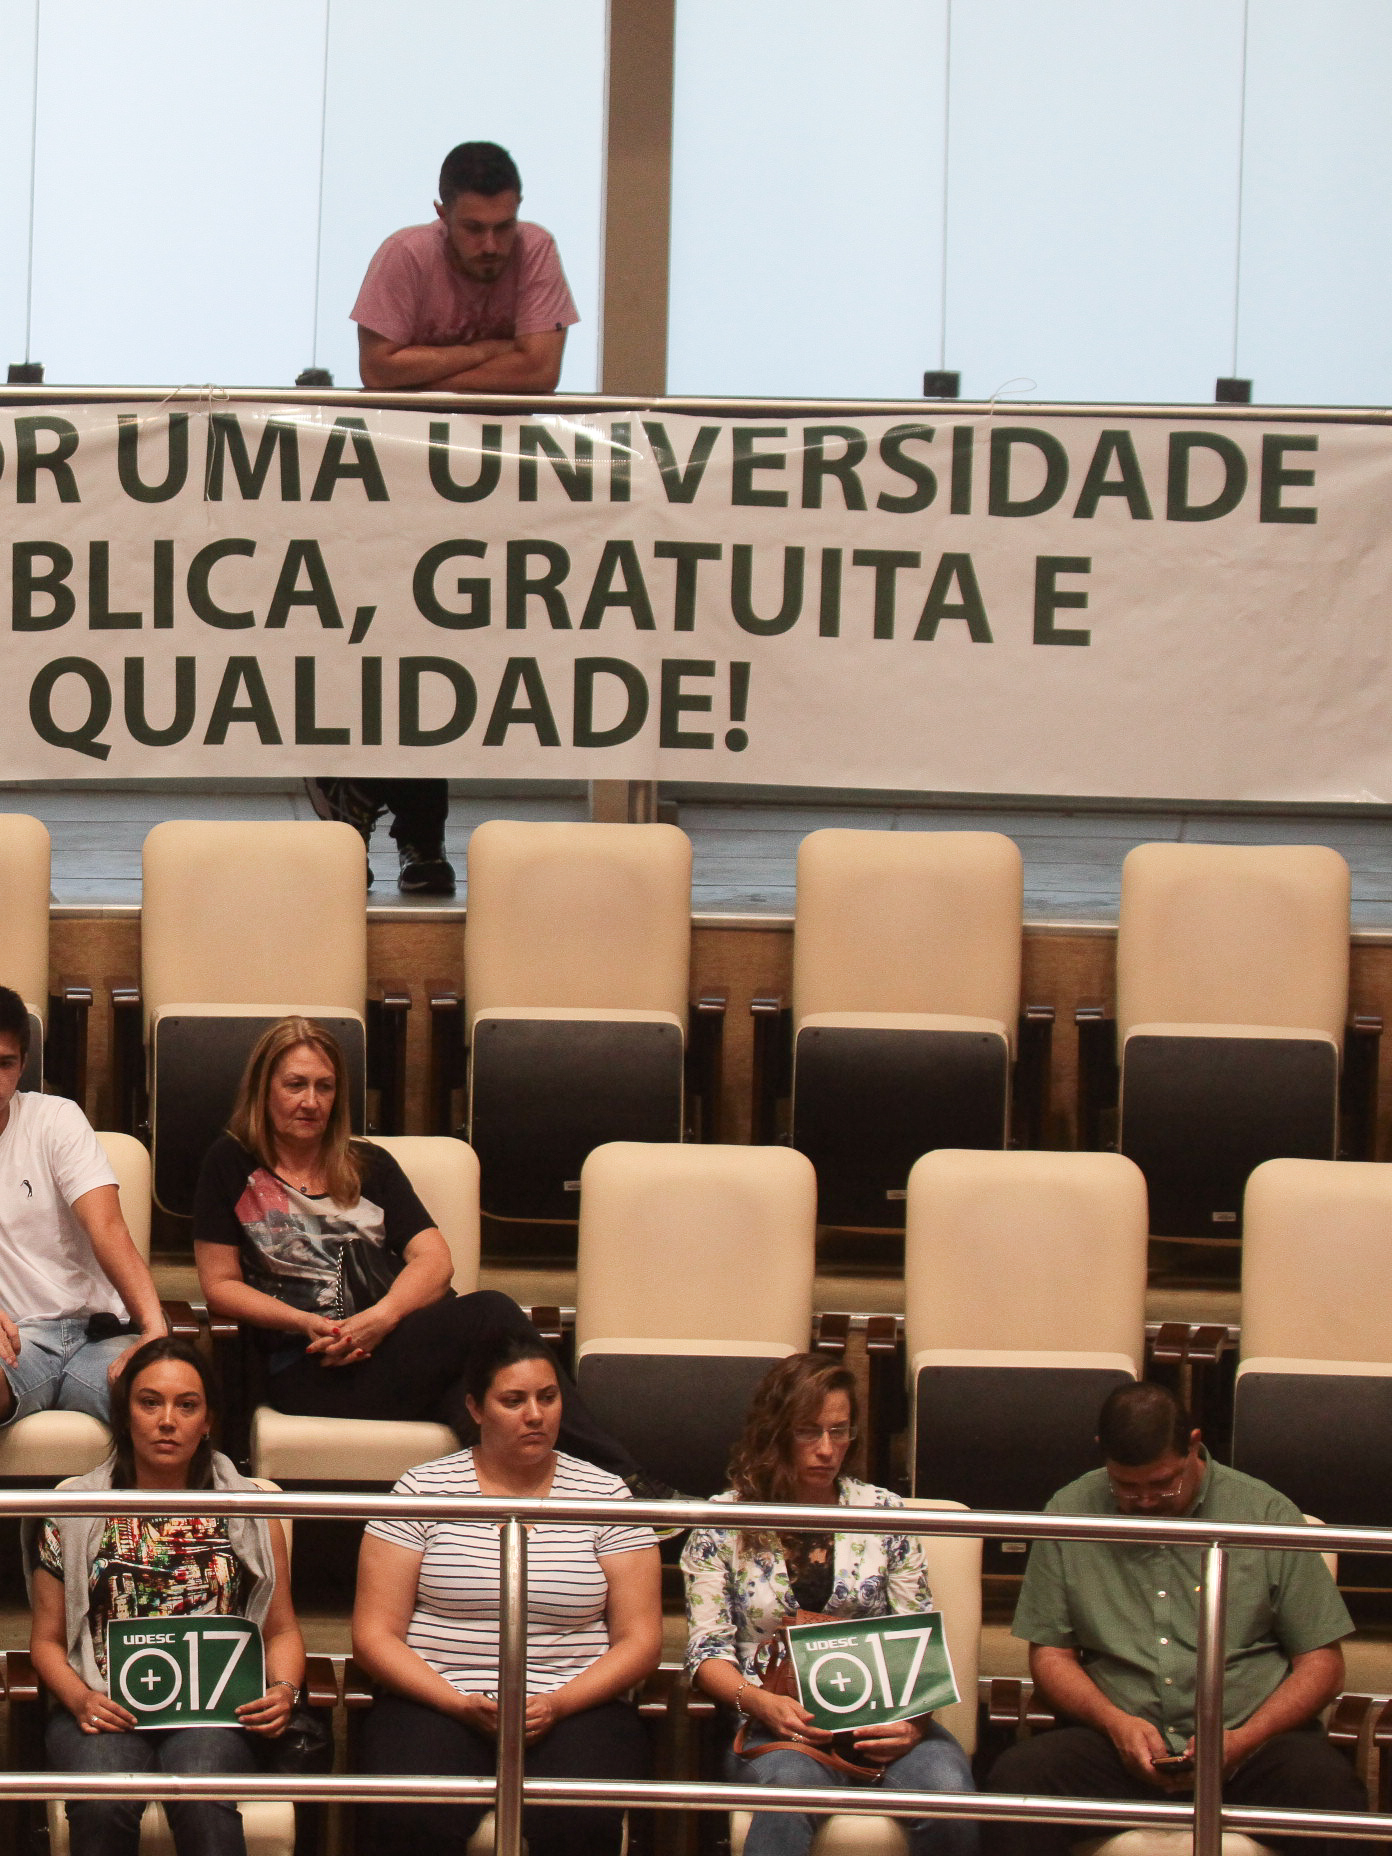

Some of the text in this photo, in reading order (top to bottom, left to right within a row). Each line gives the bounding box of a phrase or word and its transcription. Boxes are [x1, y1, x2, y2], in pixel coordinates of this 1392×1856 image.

[116, 413, 390, 503] UMA
[427, 421, 1319, 524] UNIVERSIDADE
[412, 538, 994, 644] GRATUITA
[1032, 555, 1092, 646] E
[29, 655, 752, 761] QUALIDADE!
[123, 1633, 176, 1645] UDESC
[805, 1636, 859, 1651] UDESC
